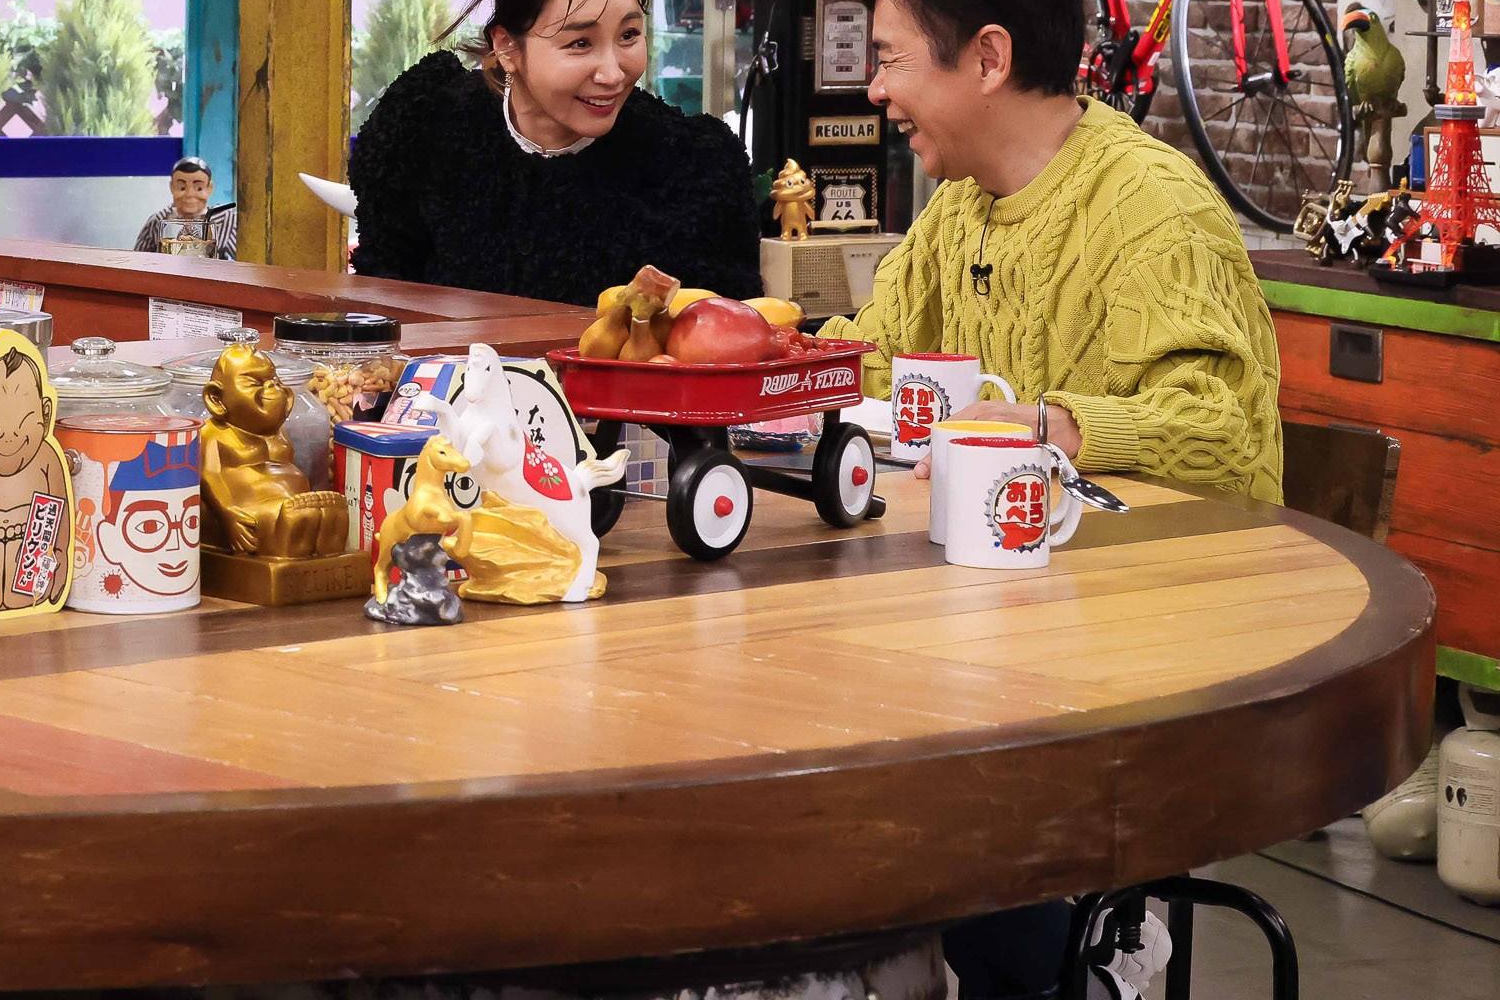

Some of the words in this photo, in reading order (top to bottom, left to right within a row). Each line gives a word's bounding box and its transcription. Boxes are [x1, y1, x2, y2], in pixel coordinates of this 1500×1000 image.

[815, 124, 875, 137] REGULAR
[831, 189, 857, 197] ROUTE
[759, 373, 799, 396] RADIO
[812, 367, 856, 390] FLYER
[900, 387, 935, 406] おか
[900, 406, 934, 424] べろ
[528, 405, 546, 450] 大阪
[1006, 481, 1044, 503] おか
[1006, 503, 1044, 524] べろ
[19, 504, 48, 587] ビリケンさん
